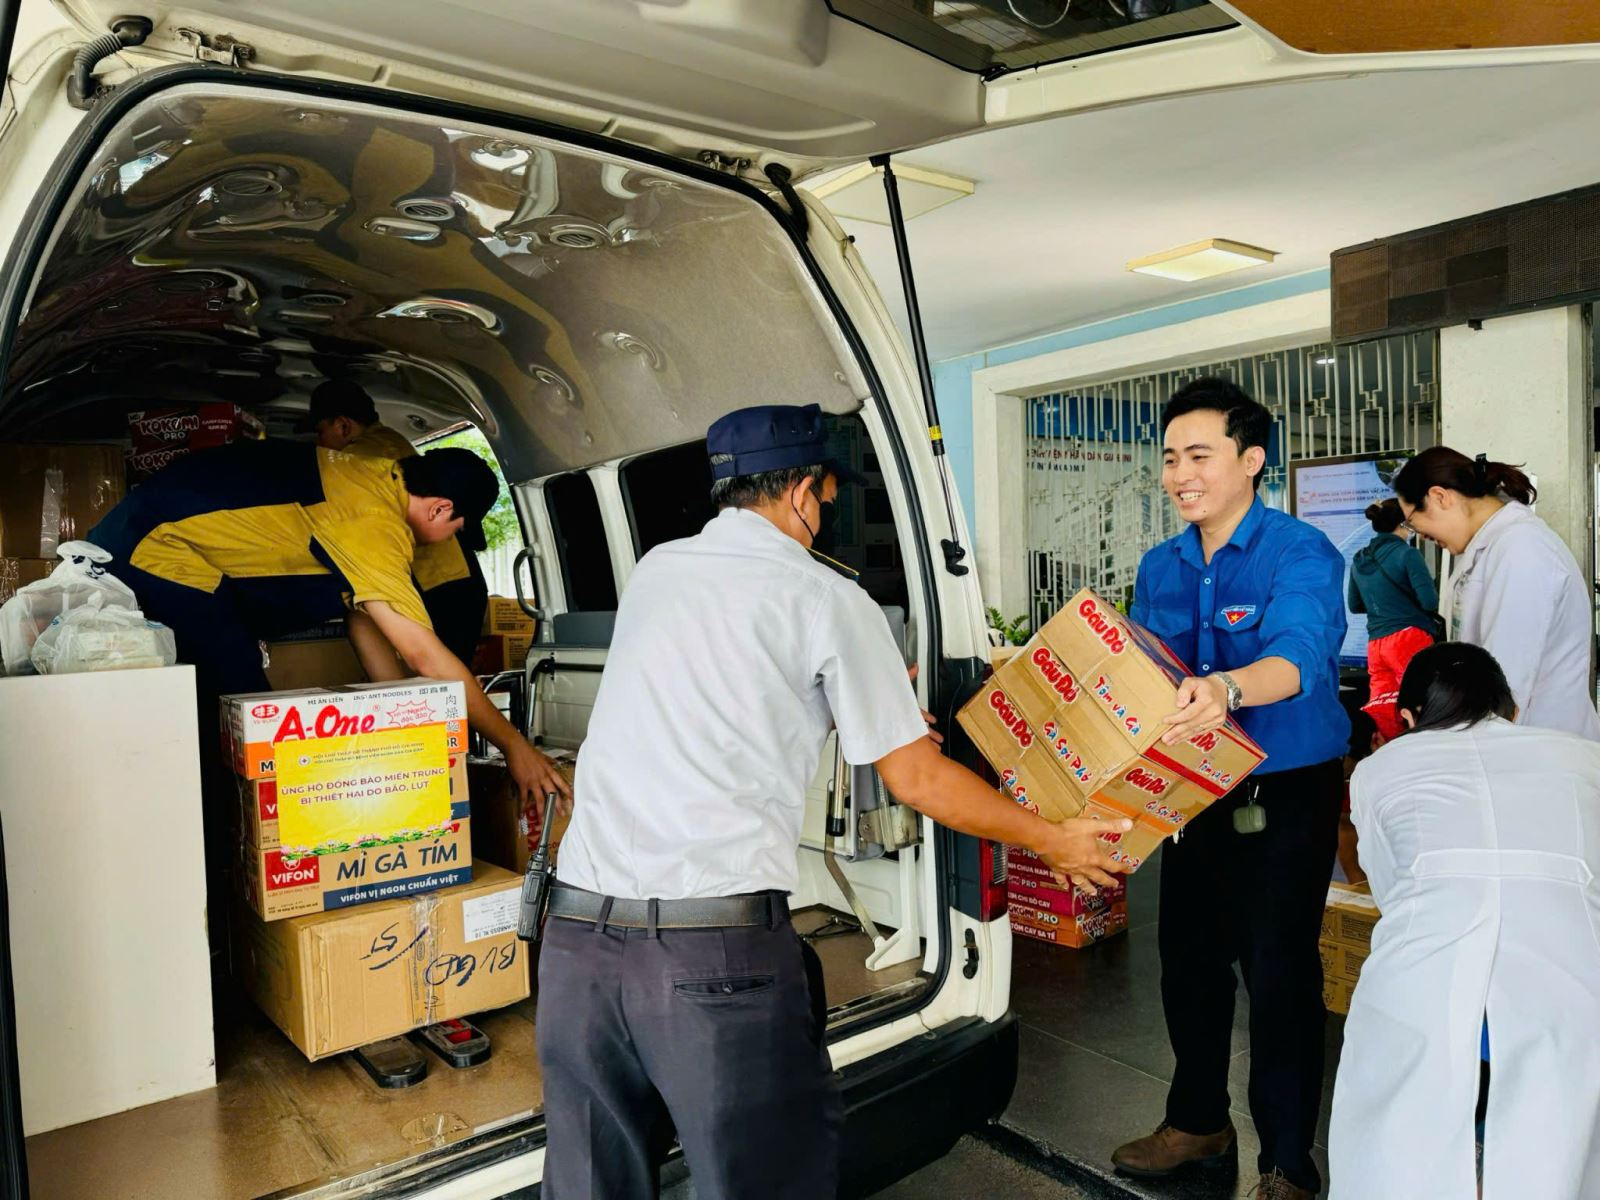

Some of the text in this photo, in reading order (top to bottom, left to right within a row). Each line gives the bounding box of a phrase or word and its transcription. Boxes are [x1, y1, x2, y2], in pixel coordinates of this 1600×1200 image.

[140, 415, 199, 435] KOKOMI
[163, 431, 186, 440] PRO
[132, 448, 190, 471] KOKO
[382, 690, 412, 698] NOODLES
[1094, 676, 1141, 735] Tôm và Gà
[273, 704, 375, 743] A-One
[1044, 721, 1058, 740] Gà
[412, 767, 446, 779] TRUNG
[366, 787, 382, 796] DO
[375, 844, 408, 873] GÀ
[418, 838, 457, 866] TÍM
[1022, 849, 1039, 859] PRO
[272, 868, 314, 885] VIFON
[1035, 868, 1049, 876] NAM
[340, 892, 367, 903] VIFON
[368, 890, 378, 898] VỊ
[380, 885, 406, 895] NGON
[439, 874, 459, 884] VIỆT
[1021, 879, 1037, 888] PRO
[1038, 900, 1050, 908] CAY
[1037, 912, 1058, 924] PRO
[1011, 922, 1056, 940] TÔM CAY SA TẾ
